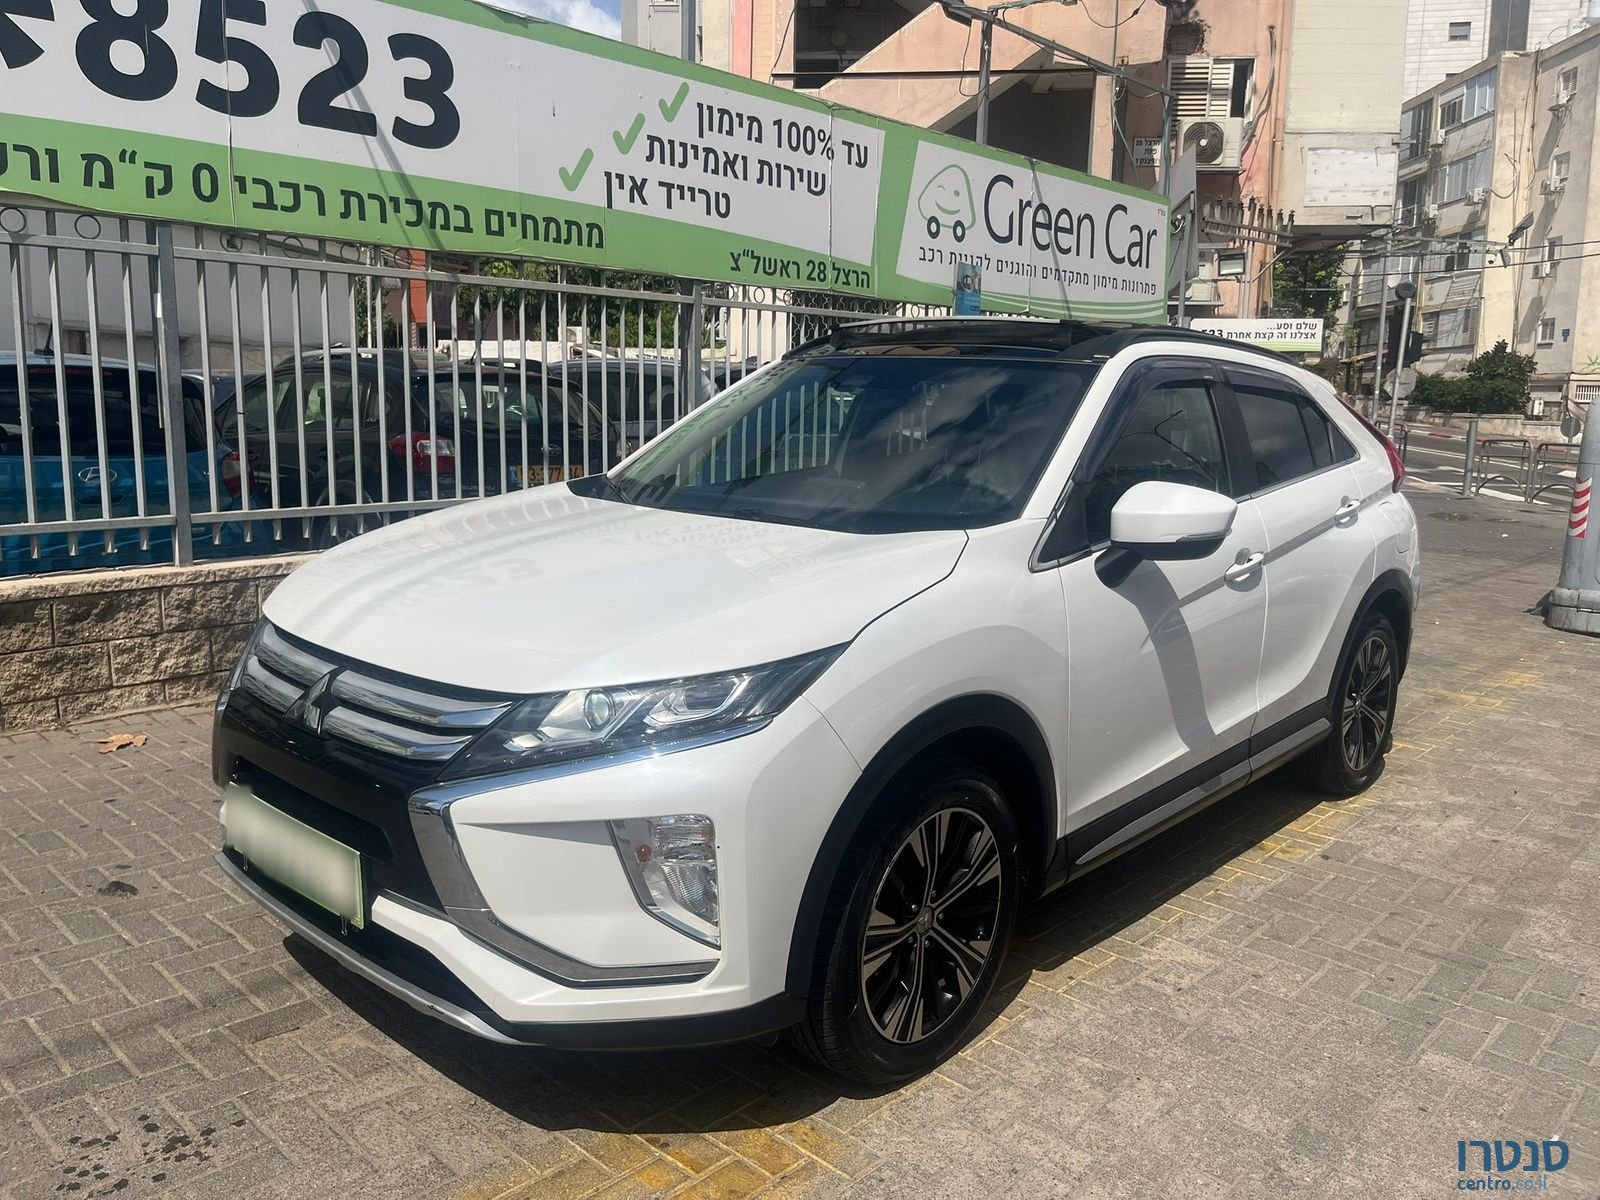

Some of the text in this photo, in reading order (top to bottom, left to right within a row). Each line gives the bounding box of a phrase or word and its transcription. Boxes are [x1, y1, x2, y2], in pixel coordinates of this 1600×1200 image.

[697, 102, 868, 169] עד 100% מימון
[645, 134, 826, 197] שירות ואמינות
[0, 142, 605, 249] מתמחים במכירת רכבי 0 ק"מ ור
[604, 171, 731, 219] טרייד אין
[983, 174, 1158, 270] Green Car
[919, 246, 943, 264] רכב
[729, 249, 870, 289] הרצל 28 ראשל"צ
[996, 258, 1037, 278] והוגנים
[1041, 266, 1089, 286] מתקדמים
[1093, 274, 1118, 291] מימון
[1120, 278, 1156, 296] פתרונות
[1226, 330, 1316, 341] אצלנו זה קצת אחרת
[1296, 322, 1317, 330] שלם
